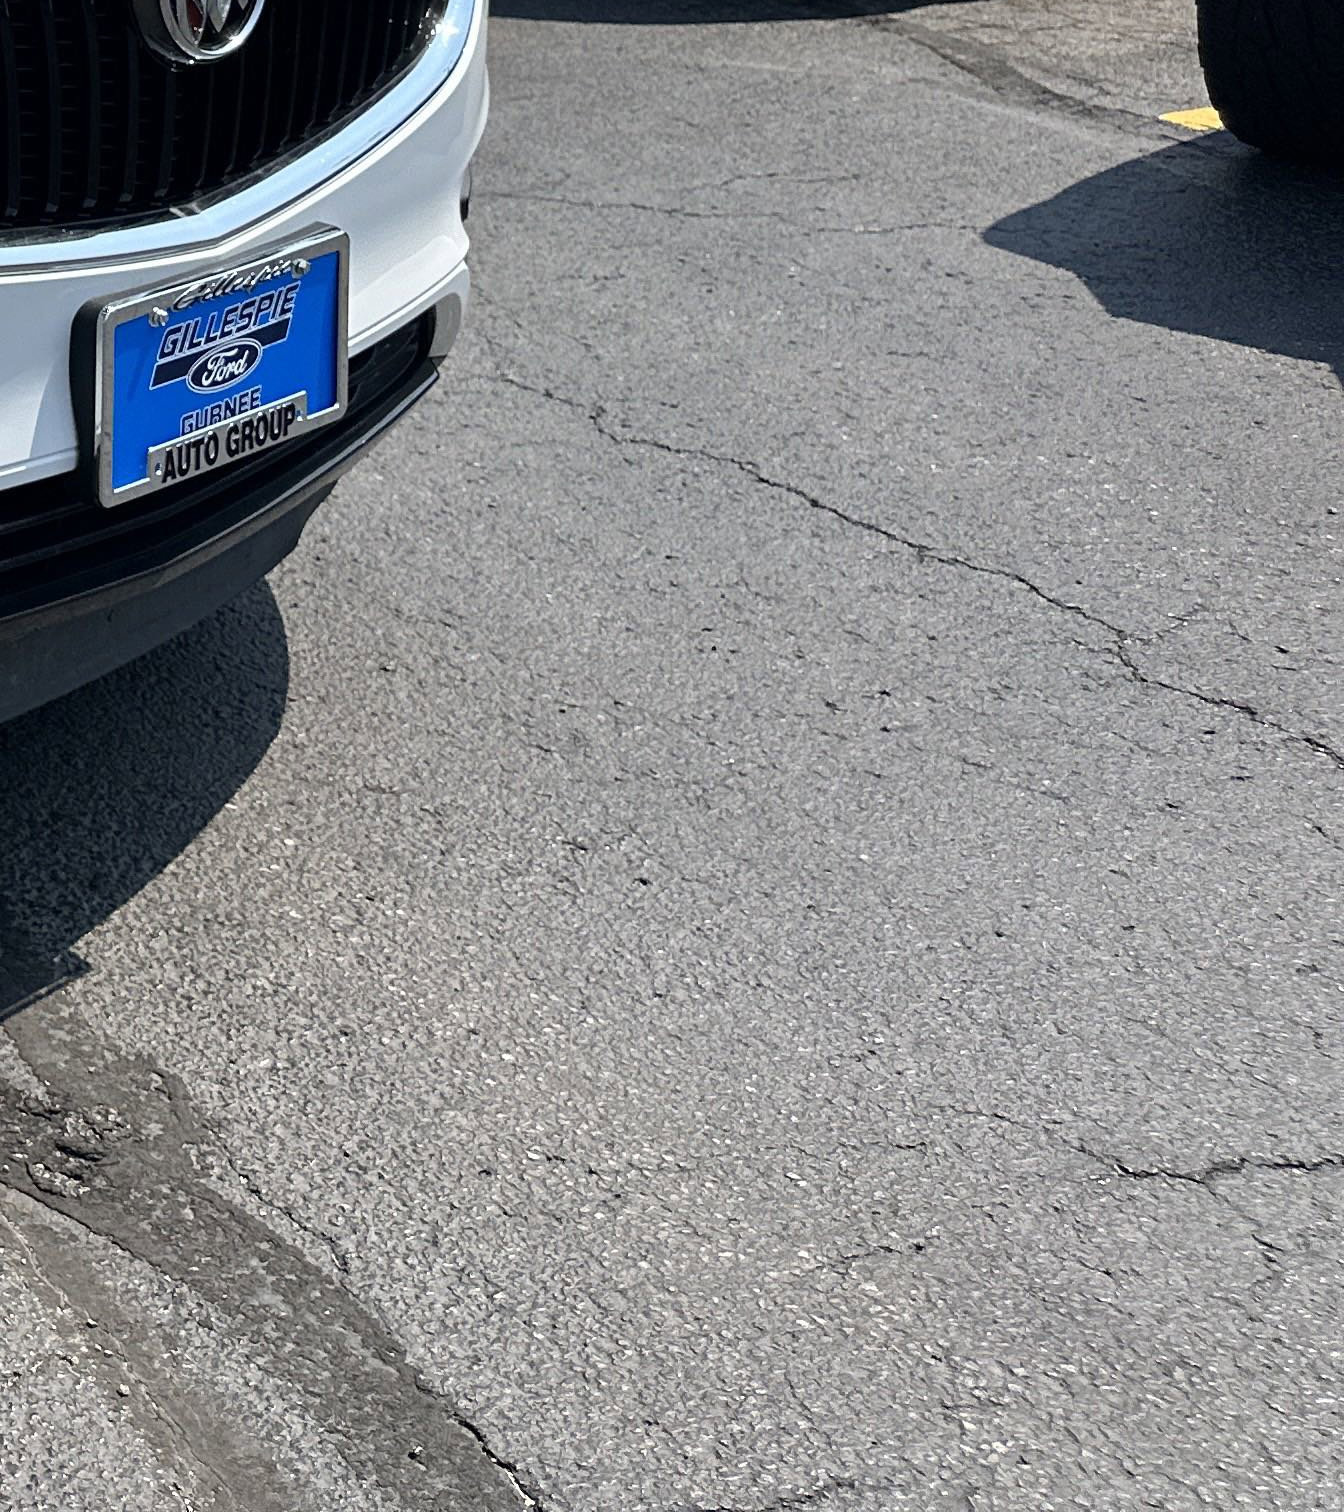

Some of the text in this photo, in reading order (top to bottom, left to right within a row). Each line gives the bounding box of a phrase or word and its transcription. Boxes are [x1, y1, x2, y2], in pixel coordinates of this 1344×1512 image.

[157, 281, 301, 361] GILLESPIE
[201, 348, 248, 386] Ford
[162, 403, 296, 483] AUTO GROUP
[180, 385, 262, 436] GURNEE
